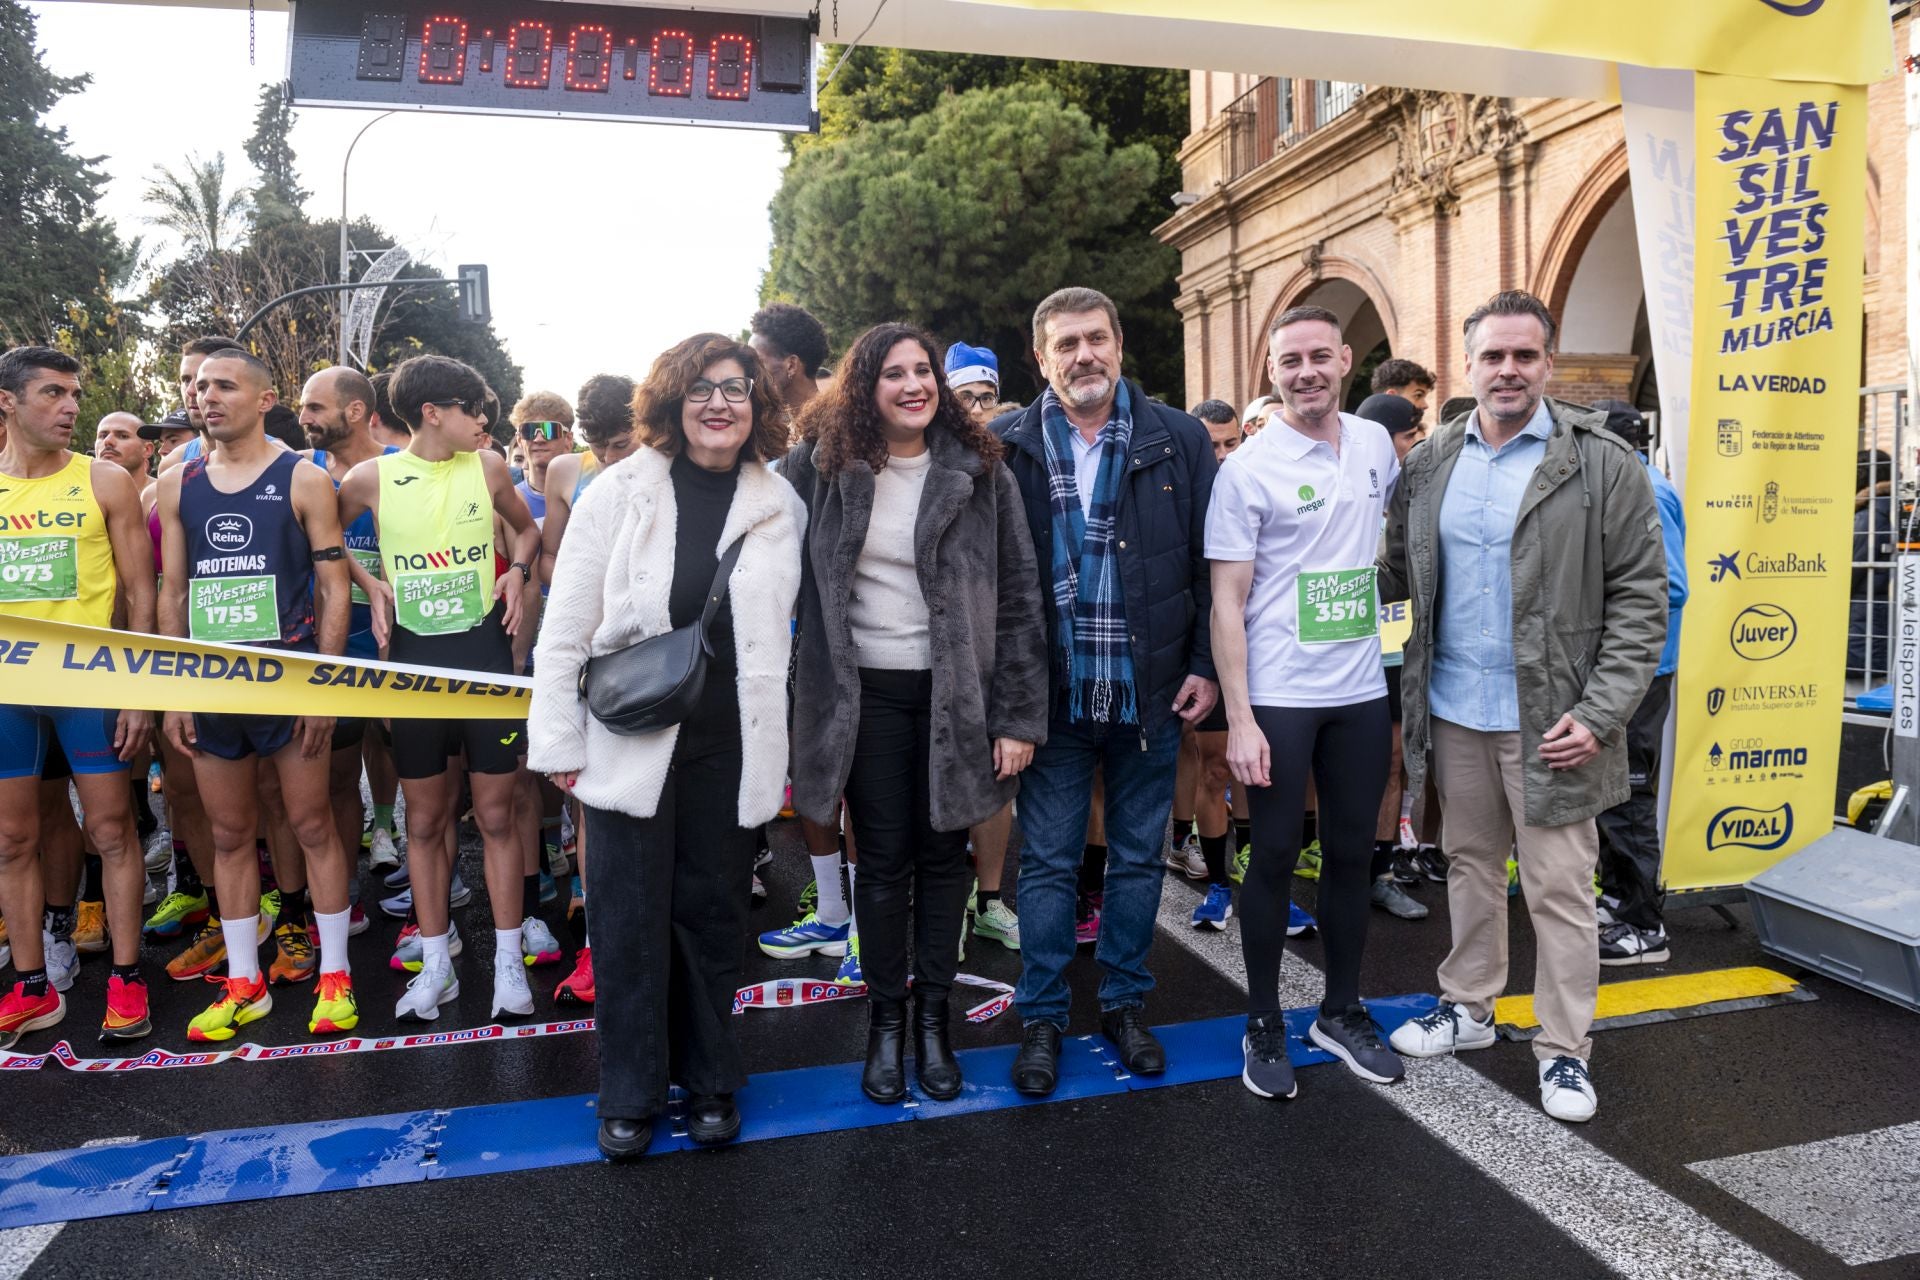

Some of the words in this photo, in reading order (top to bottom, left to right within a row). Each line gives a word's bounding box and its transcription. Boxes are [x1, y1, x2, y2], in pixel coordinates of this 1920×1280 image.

[1716, 101, 1839, 162] SAN
[1729, 154, 1821, 214] SIL
[1716, 202, 1829, 267] VES
[1718, 257, 1829, 319] TRE
[1719, 306, 1834, 354] MURCIA
[1719, 374, 1748, 391] LA
[1752, 375, 1826, 393] VERDAD
[1297, 497, 1326, 516] megar
[1791, 507, 1818, 515] Murcia
[212, 532, 245, 543] Reina
[34, 551, 68, 564] MURCIA
[196, 554, 267, 575] PROTEINAS
[1746, 552, 1827, 574] CaixaBank
[2, 563, 54, 582] 073
[1306, 573, 1339, 593] SAN
[196, 580, 268, 609] SILVESTRE
[197, 582, 222, 598] SAN
[403, 576, 433, 592] SAN
[403, 572, 475, 603] SILVESTRE
[446, 584, 474, 598] MURCIA
[1306, 570, 1372, 606] SILVESTRE
[1351, 584, 1371, 600] MURCIA
[235, 591, 267, 604] MURCIA
[419, 597, 465, 618] 092
[205, 605, 258, 625] 1755
[1314, 598, 1368, 623] 3576
[1736, 624, 1789, 643] Juver
[62, 643, 117, 673] LA
[122, 647, 285, 683] VERDAD
[307, 663, 388, 689] SAN
[1732, 684, 1817, 701] UNIVERSAE
[1729, 747, 1807, 770] marmo
[1721, 817, 1781, 838] VIDAL
[270, 1041, 350, 1058] FAMU
[415, 1029, 493, 1045] FAMU
